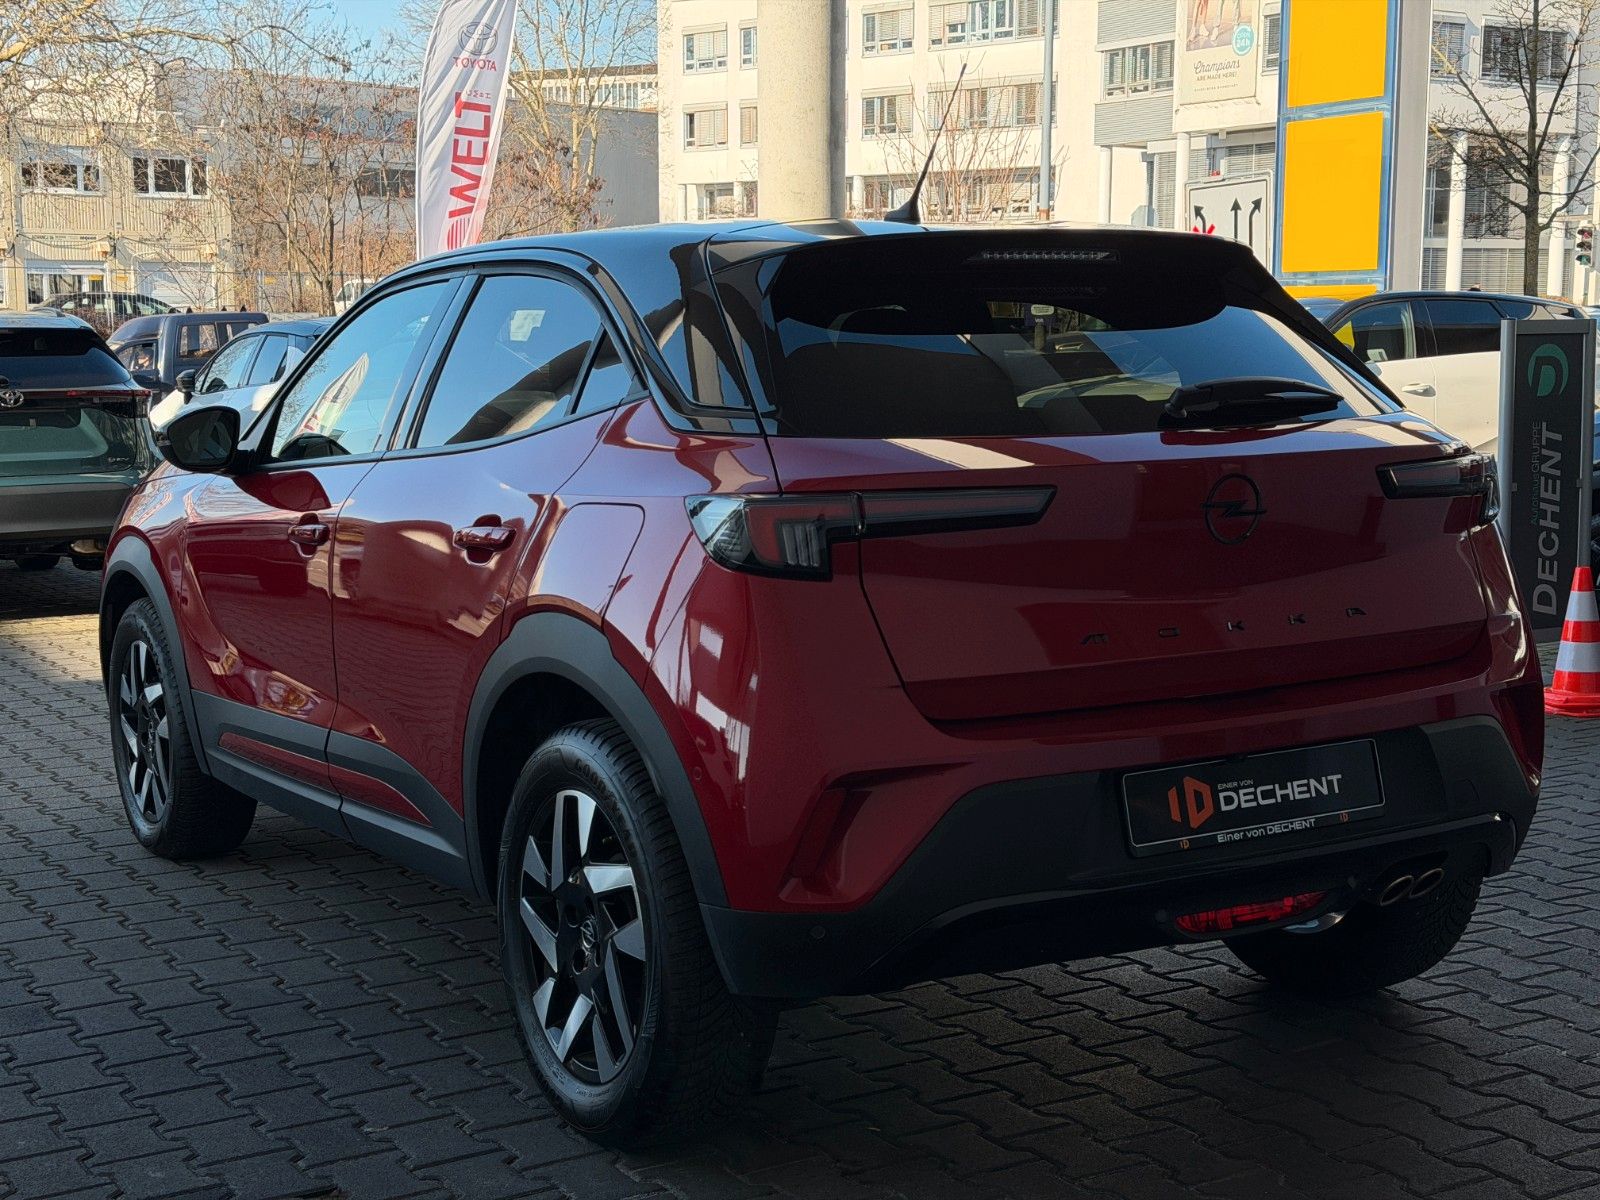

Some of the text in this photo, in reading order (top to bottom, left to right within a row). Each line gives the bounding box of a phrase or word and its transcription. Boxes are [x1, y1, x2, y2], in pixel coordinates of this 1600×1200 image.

[1237, 38, 1250, 48] 24h
[453, 56, 497, 71] TOYOTA
[1194, 60, 1240, 74] Champions
[1533, 422, 1563, 615] DECHENT
[1239, 779, 1254, 787] VON
[1219, 775, 1341, 811] DECHENT
[1217, 818, 1315, 843] Einer von DECHENT
